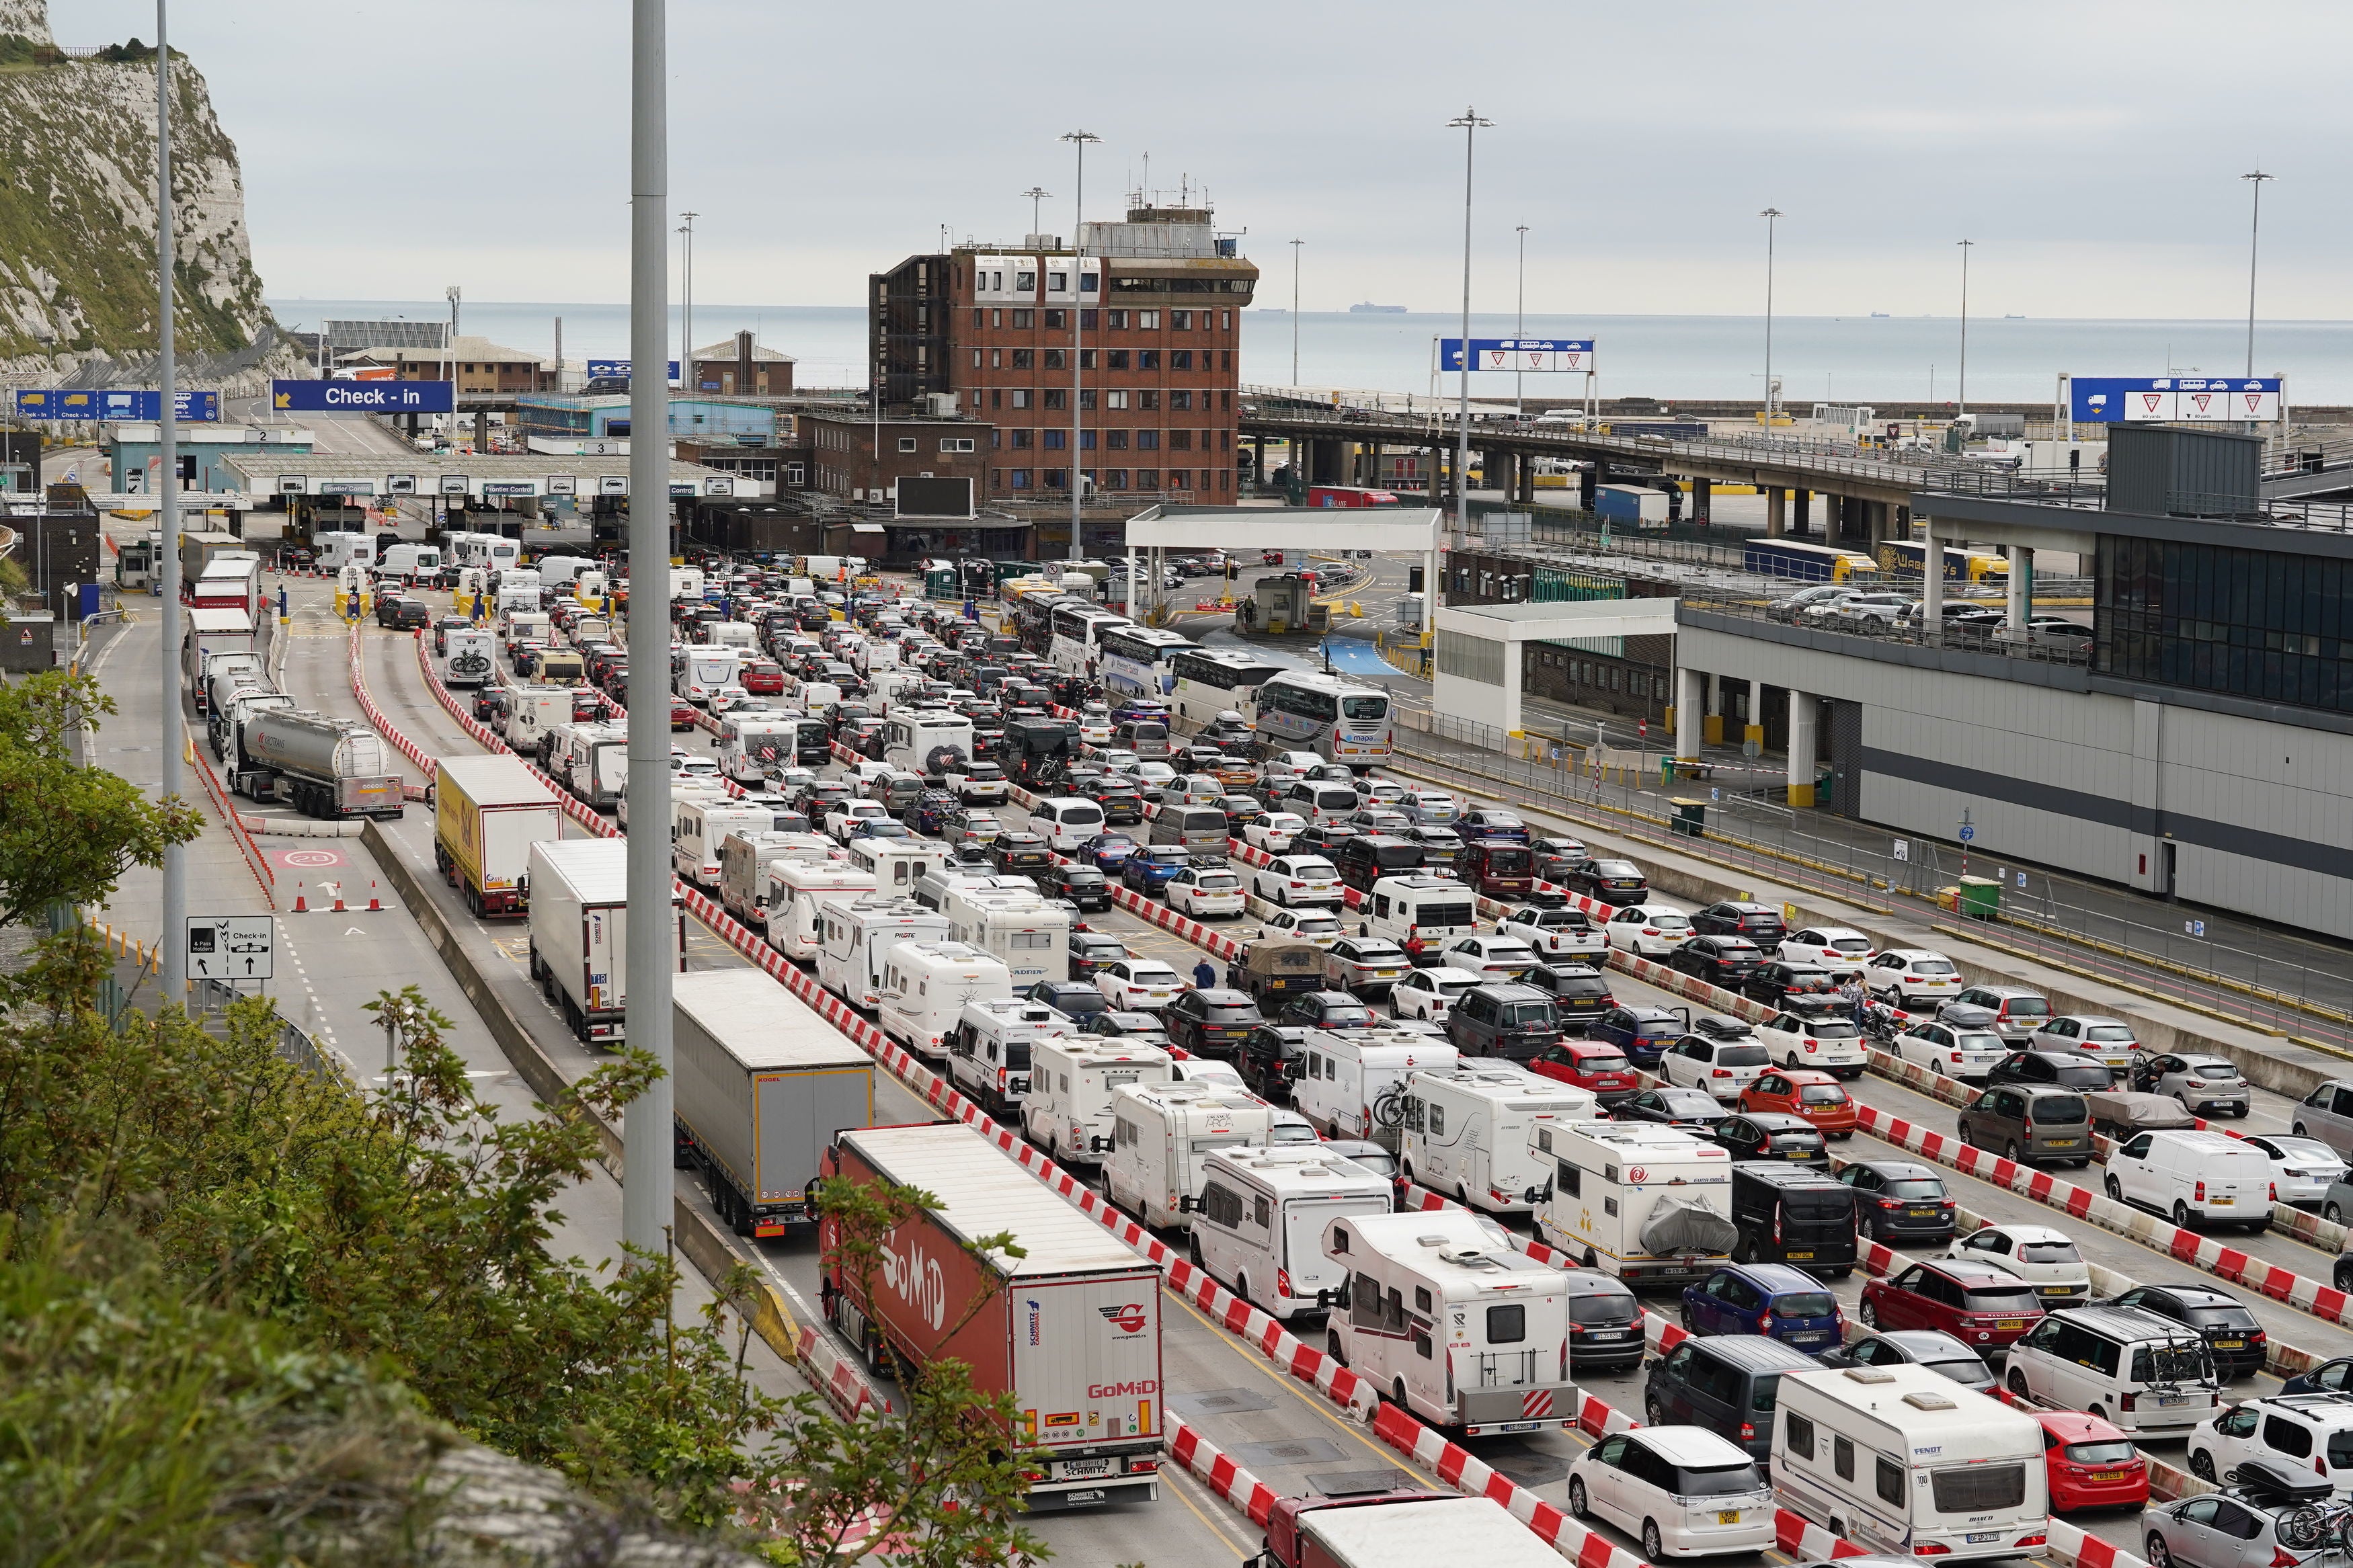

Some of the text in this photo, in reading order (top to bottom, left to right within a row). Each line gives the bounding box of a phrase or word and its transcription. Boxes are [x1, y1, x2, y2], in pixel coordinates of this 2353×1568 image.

[325, 388, 386, 404] Check
[403, 388, 420, 404] in
[260, 431, 267, 441] 2
[598, 444, 604, 453] 3
[592, 975, 606, 983] TIR
[1088, 1379, 1156, 1399] GoMiD
[1914, 1447, 1942, 1455] FENDT
[1065, 1467, 1107, 1476] SCHMITZ
[1917, 1475, 1927, 1485] 100
